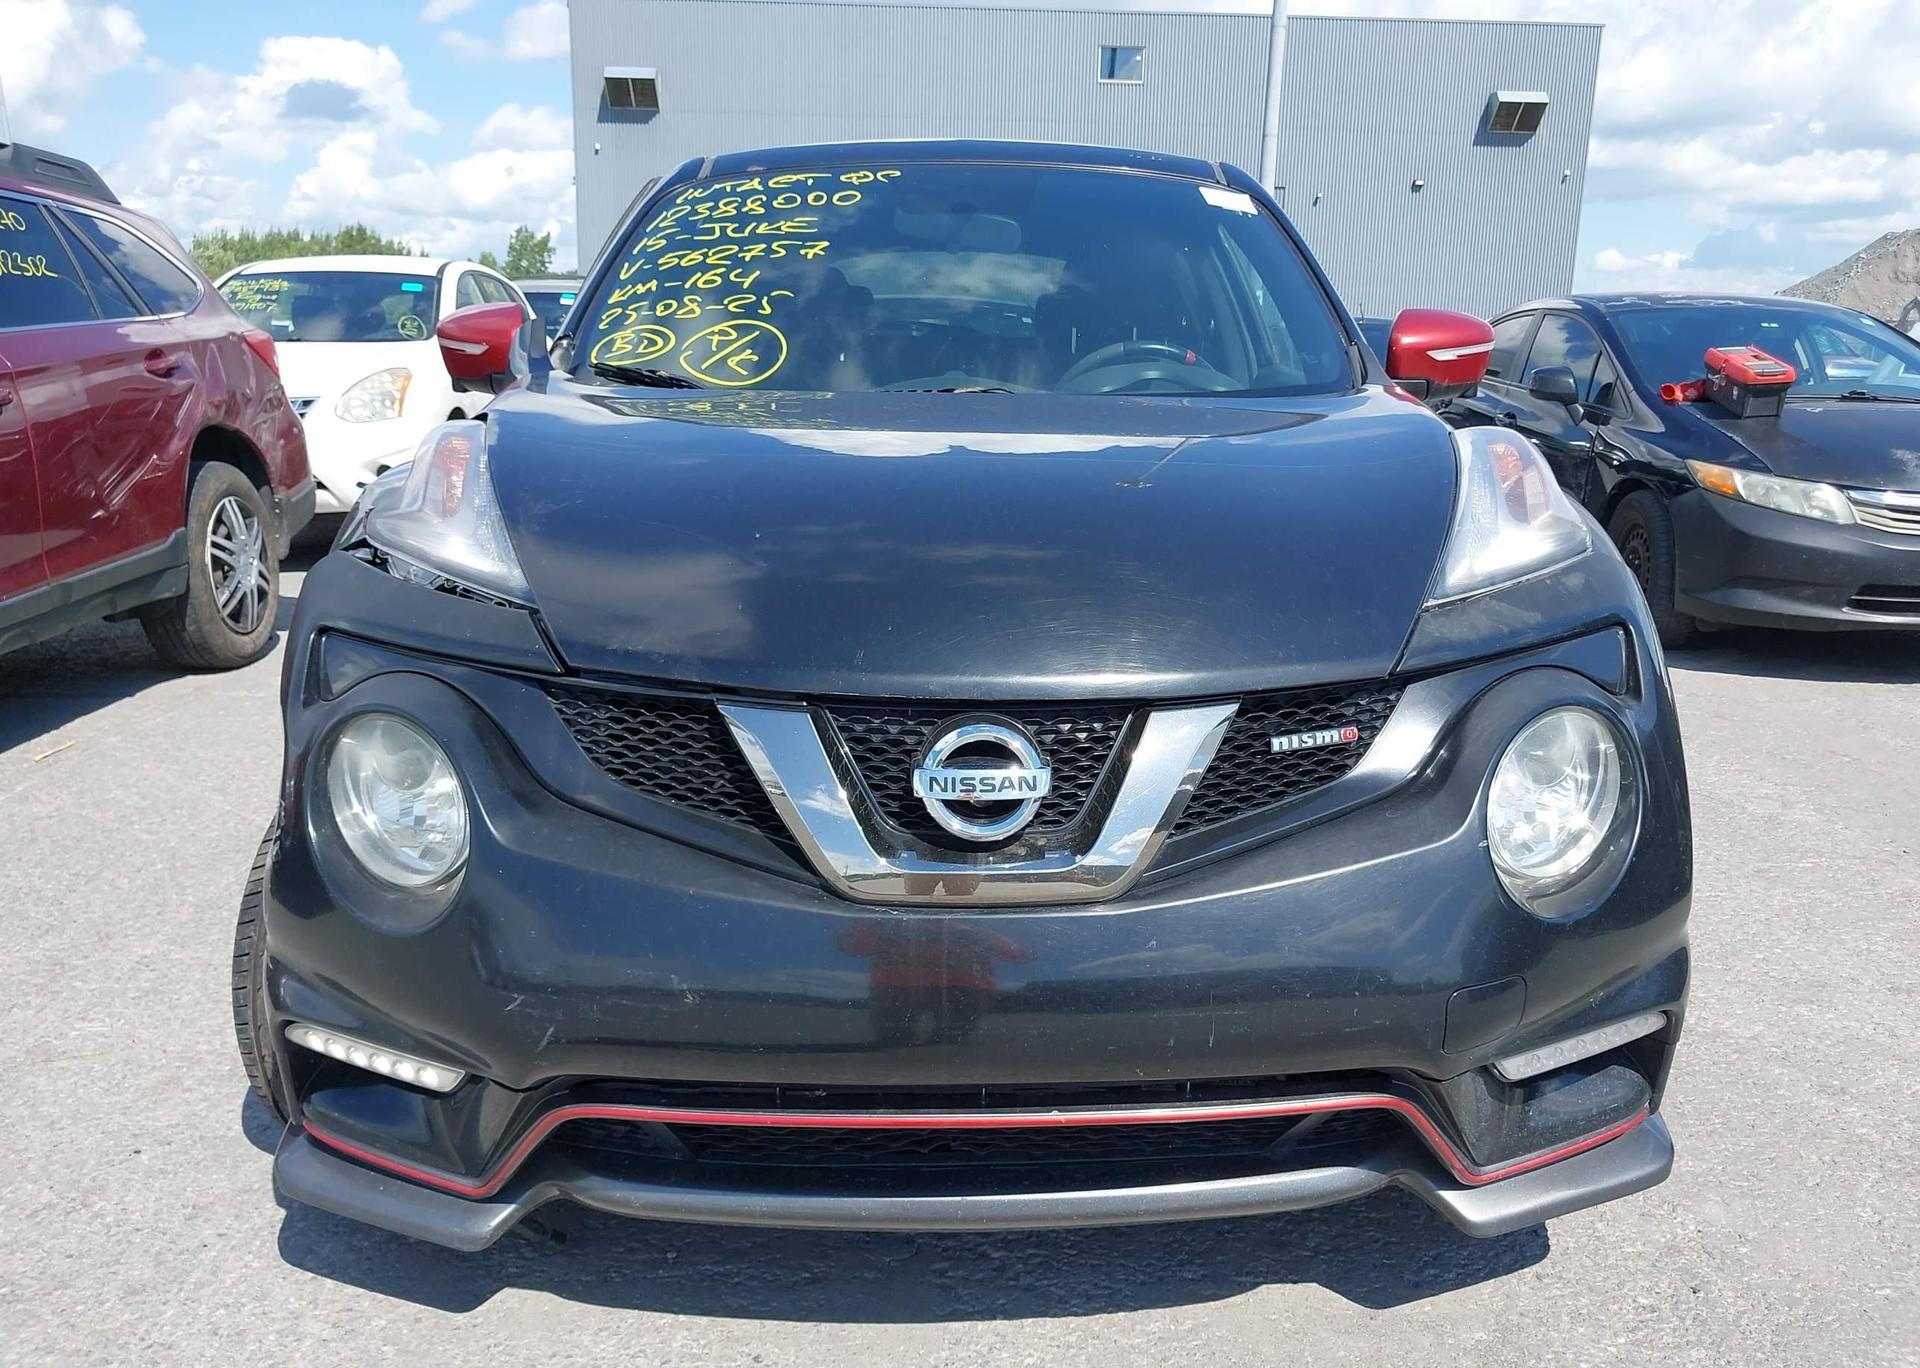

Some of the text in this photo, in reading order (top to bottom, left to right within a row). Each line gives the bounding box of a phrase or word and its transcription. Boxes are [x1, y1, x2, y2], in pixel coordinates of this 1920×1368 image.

[646, 190, 862, 232] 12388000
[598, 290, 795, 330] 25-08-25
[605, 332, 665, 358] BD
[1271, 726, 1358, 753] nismo
[928, 775, 1037, 793] NISSAN
